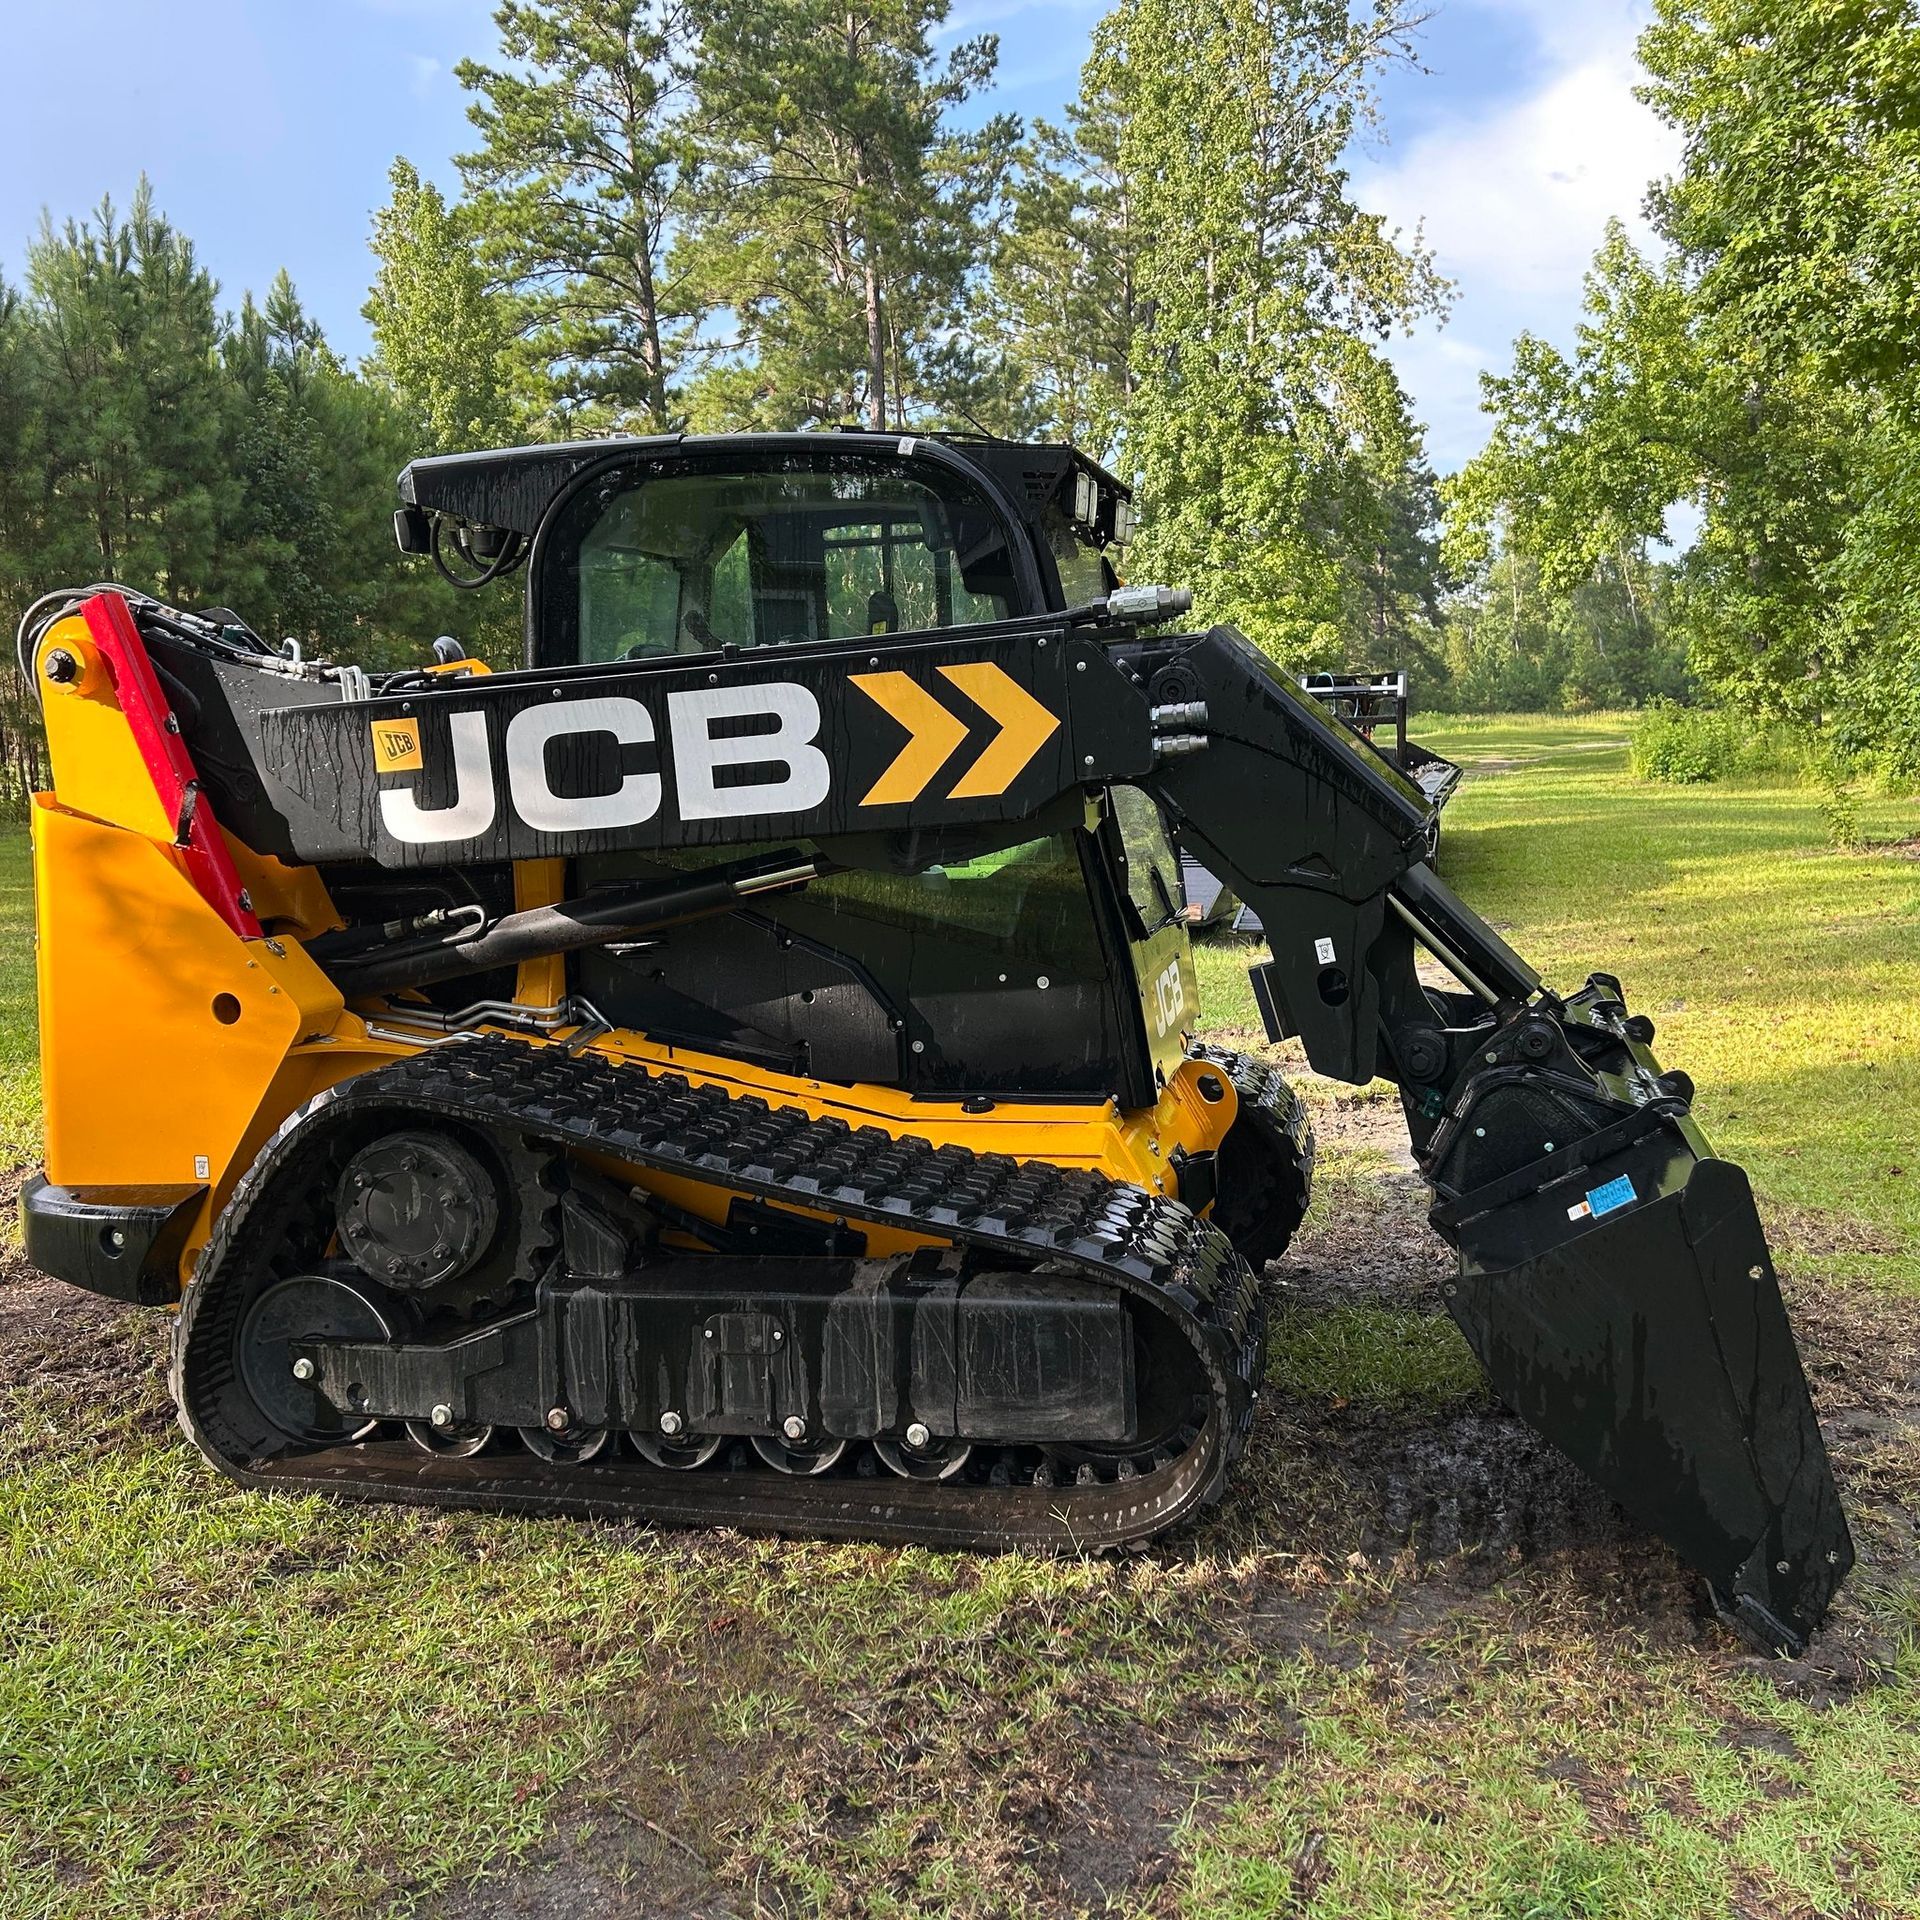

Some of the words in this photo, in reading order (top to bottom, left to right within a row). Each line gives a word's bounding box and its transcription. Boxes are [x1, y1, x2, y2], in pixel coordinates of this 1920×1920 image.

[379, 682, 830, 843] JCB
[384, 733, 414, 758] JCB
[1155, 960, 1184, 1038] JCB
